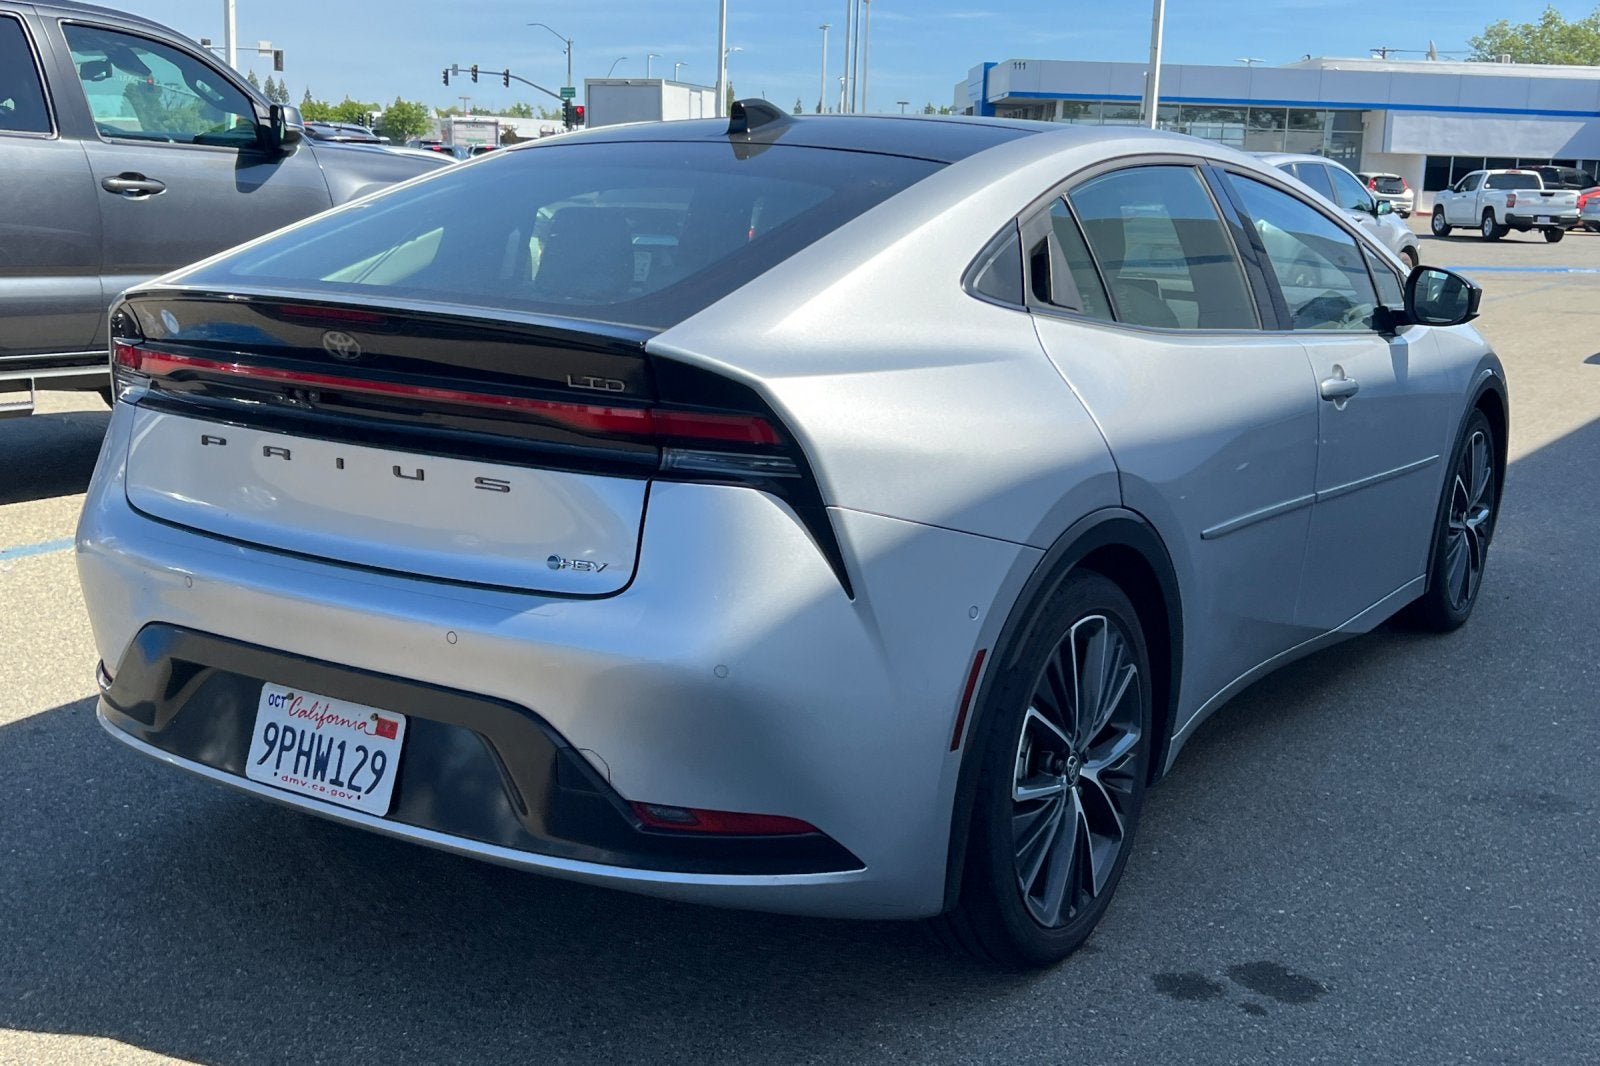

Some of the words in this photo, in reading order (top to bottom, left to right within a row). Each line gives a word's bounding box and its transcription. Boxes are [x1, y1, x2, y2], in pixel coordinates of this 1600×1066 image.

[567, 374, 625, 392] LTD
[201, 434, 511, 493] PRIUS
[560, 558, 608, 573] HEV
[268, 693, 288, 708] OCT
[288, 696, 377, 736] California
[257, 721, 387, 795] 9PHW129
[281, 774, 354, 800] dmv.ca.gov
